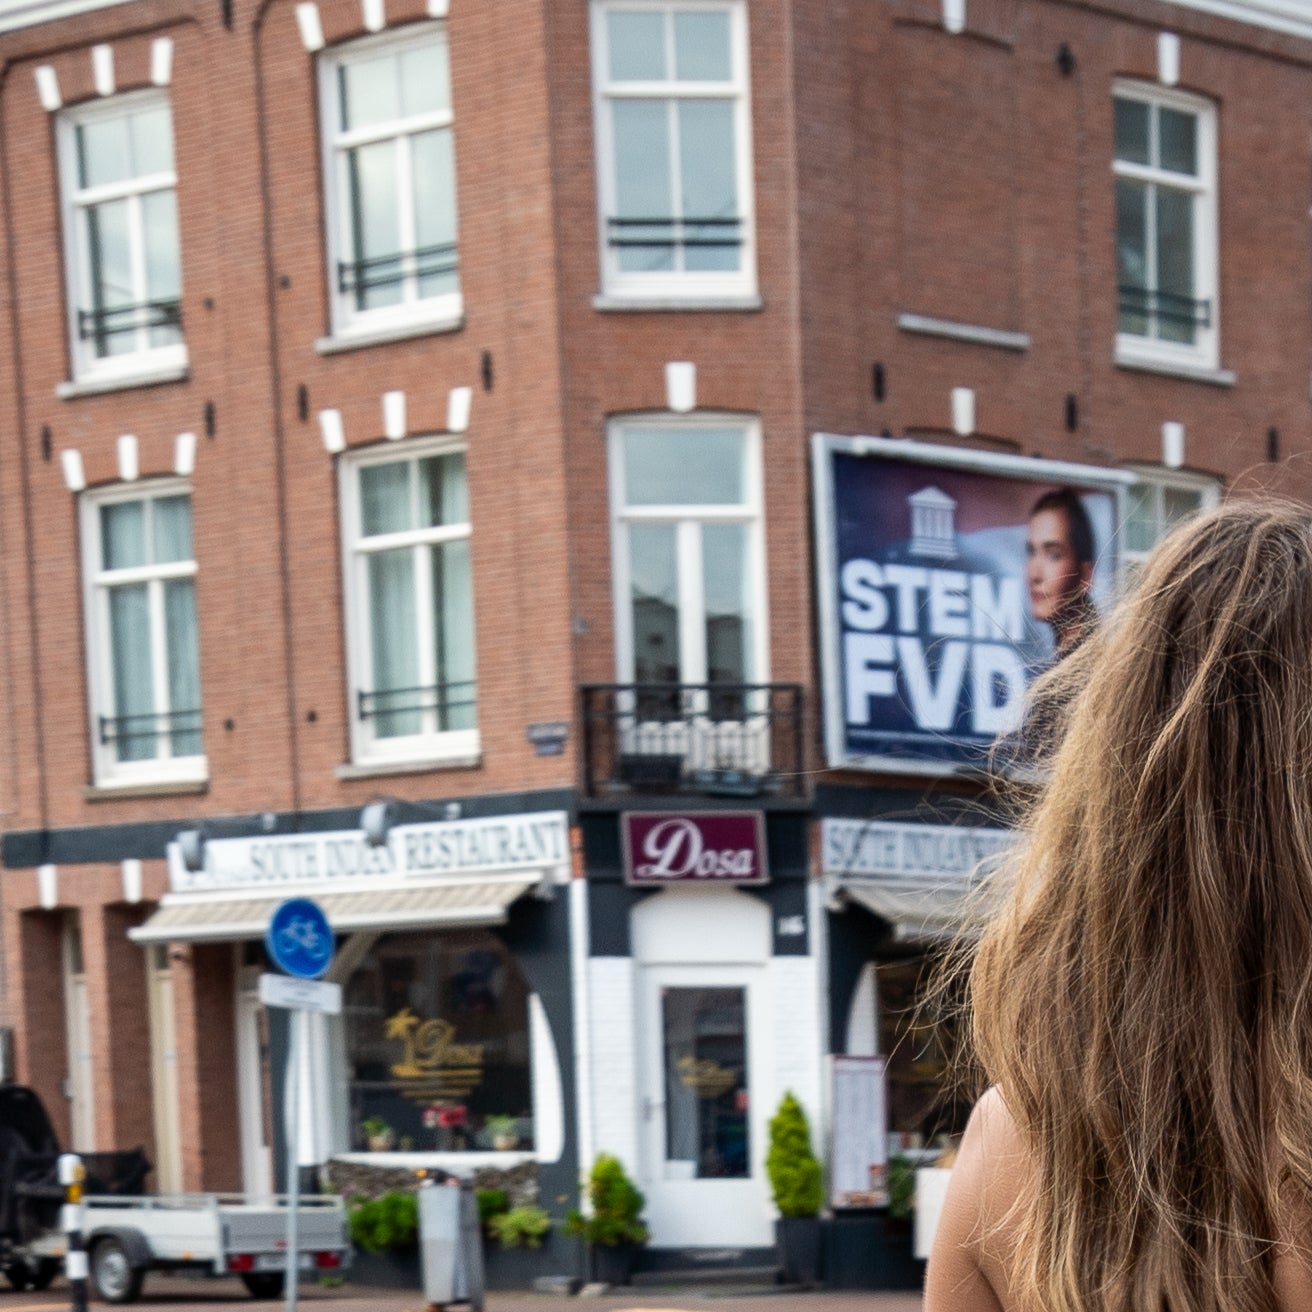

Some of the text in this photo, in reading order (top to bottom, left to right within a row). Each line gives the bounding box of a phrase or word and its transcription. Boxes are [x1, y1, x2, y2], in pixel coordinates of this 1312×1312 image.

[841, 558, 1026, 641] STEM
[844, 631, 1030, 734] FVD
[250, 841, 318, 881] SOUTH
[404, 820, 562, 871] RESTAURANT
[635, 818, 754, 878] Dosa
